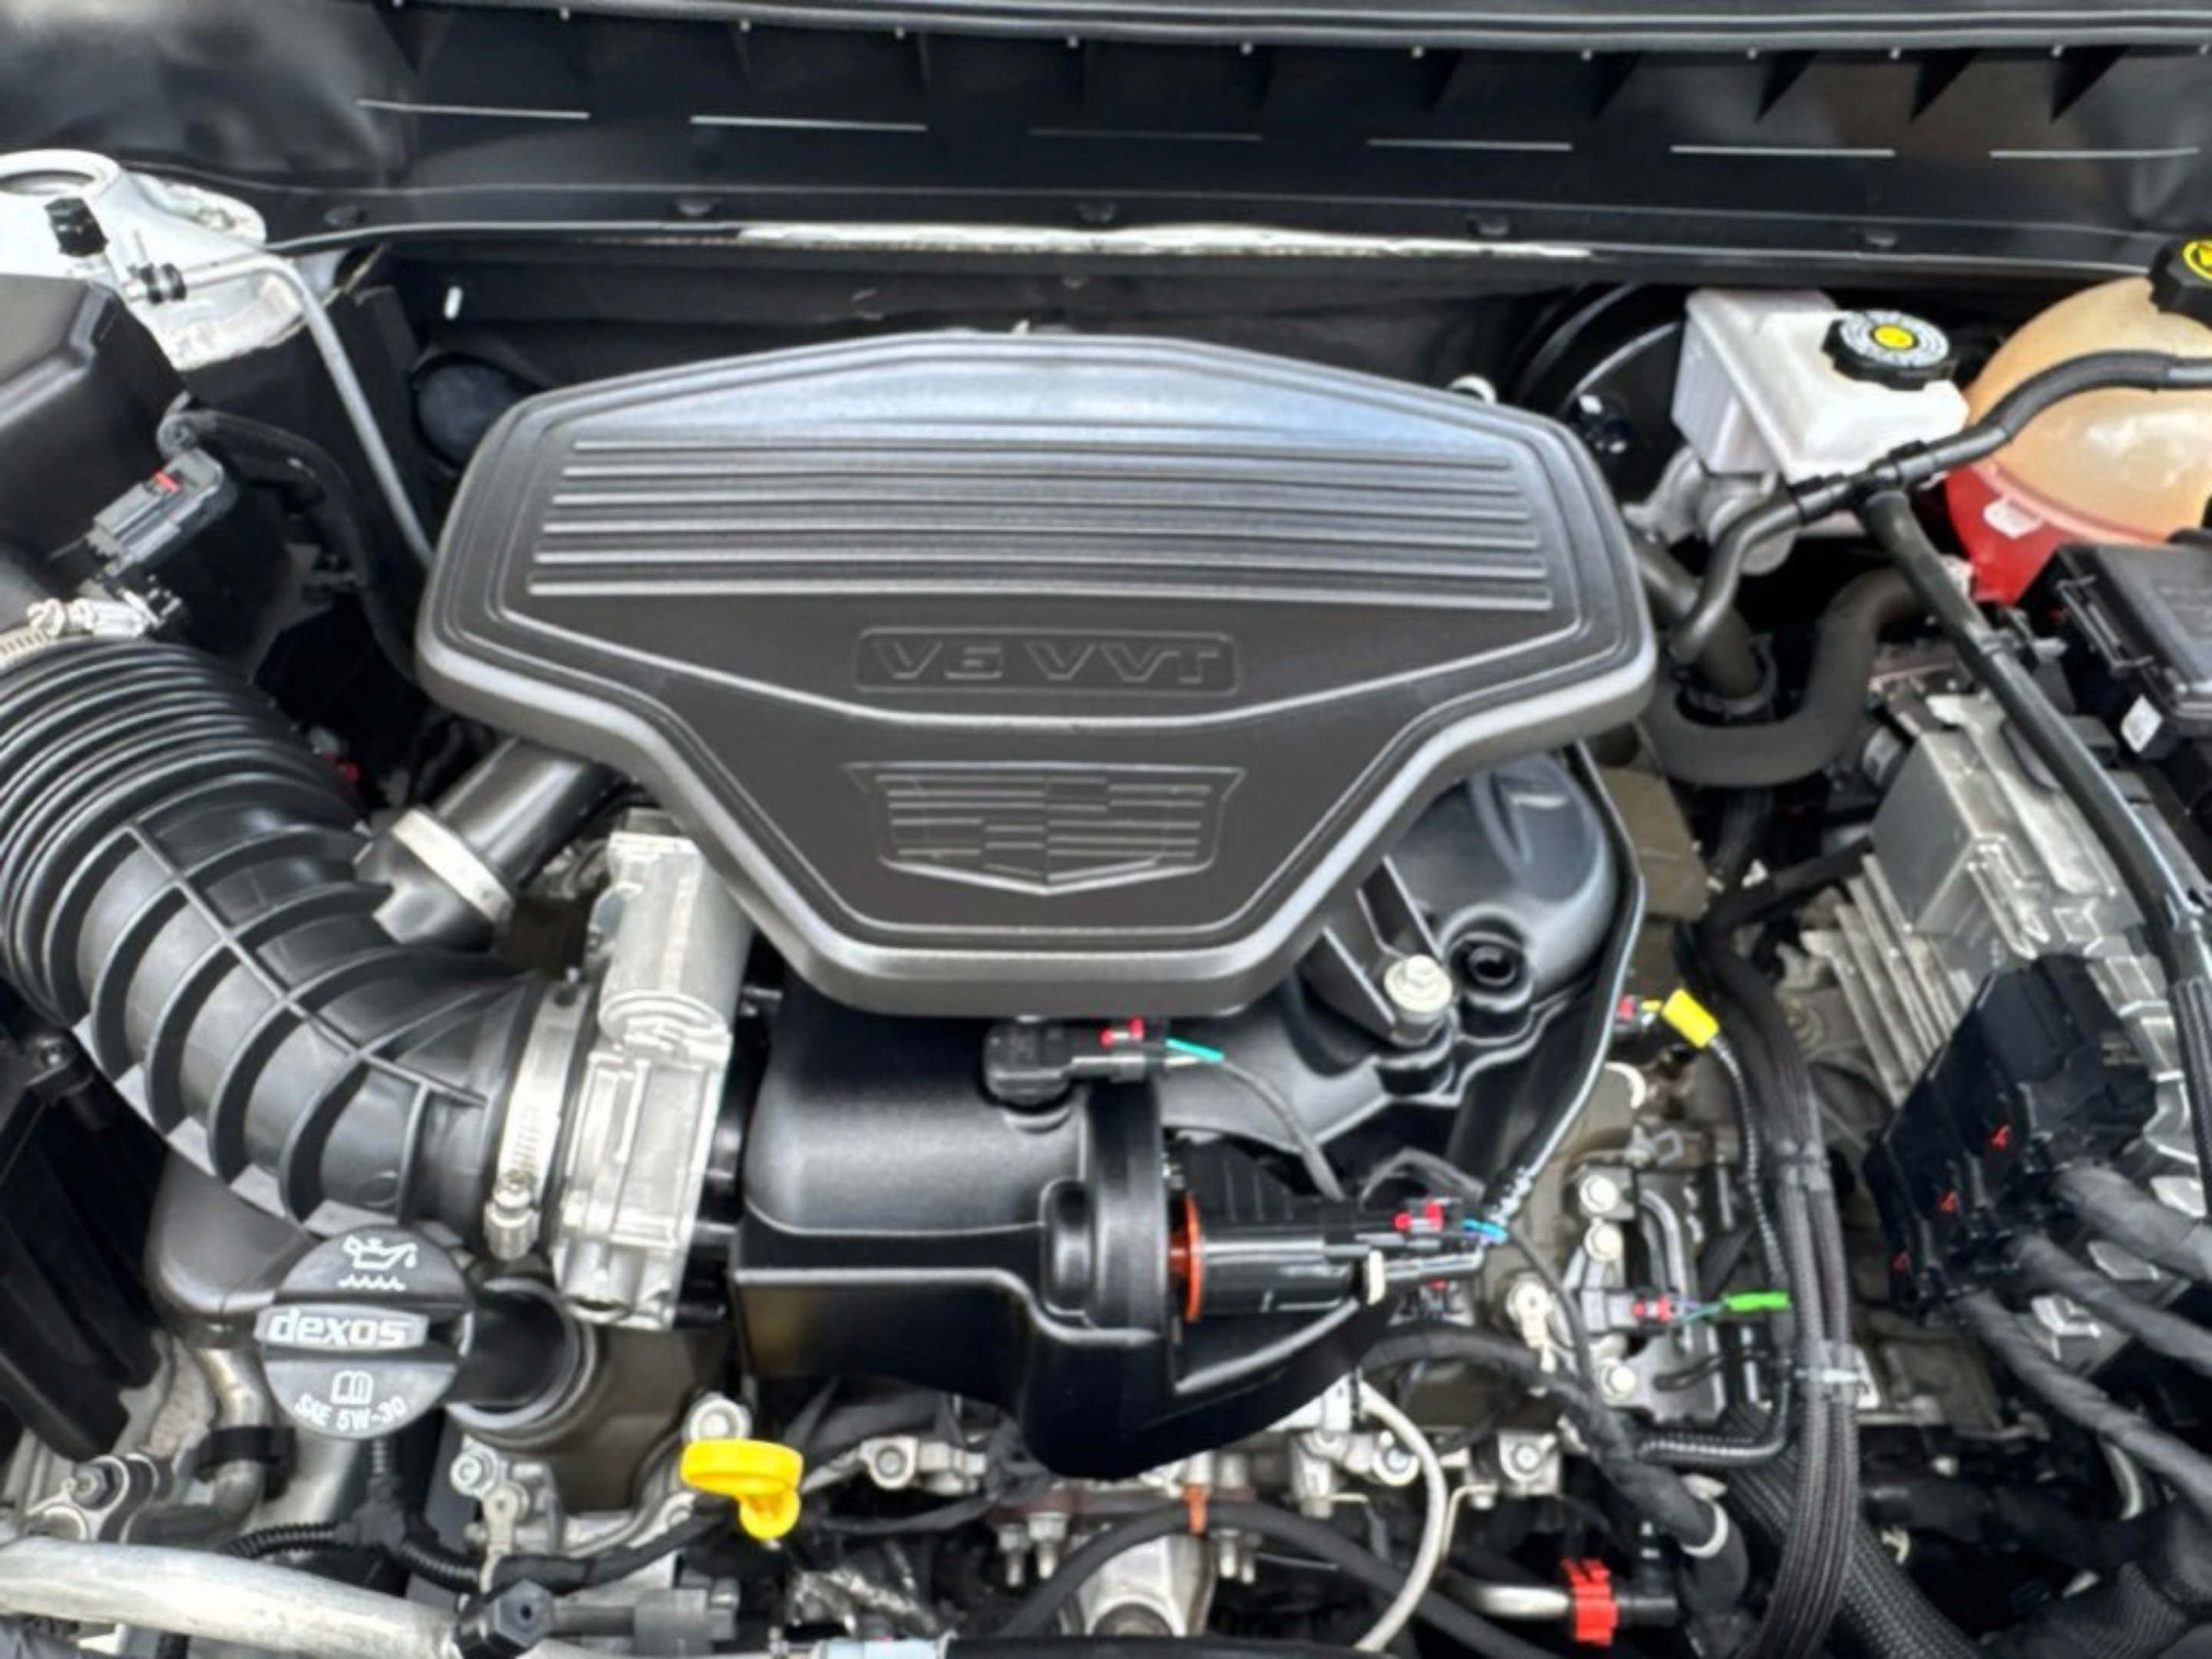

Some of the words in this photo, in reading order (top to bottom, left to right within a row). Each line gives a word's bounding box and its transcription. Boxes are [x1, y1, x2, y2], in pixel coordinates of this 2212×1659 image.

[1024, 640, 1221, 684] VVT
[268, 1307, 412, 1346] dexos
[295, 1393, 332, 1426] SAE
[336, 1396, 406, 1431] 5W-30
